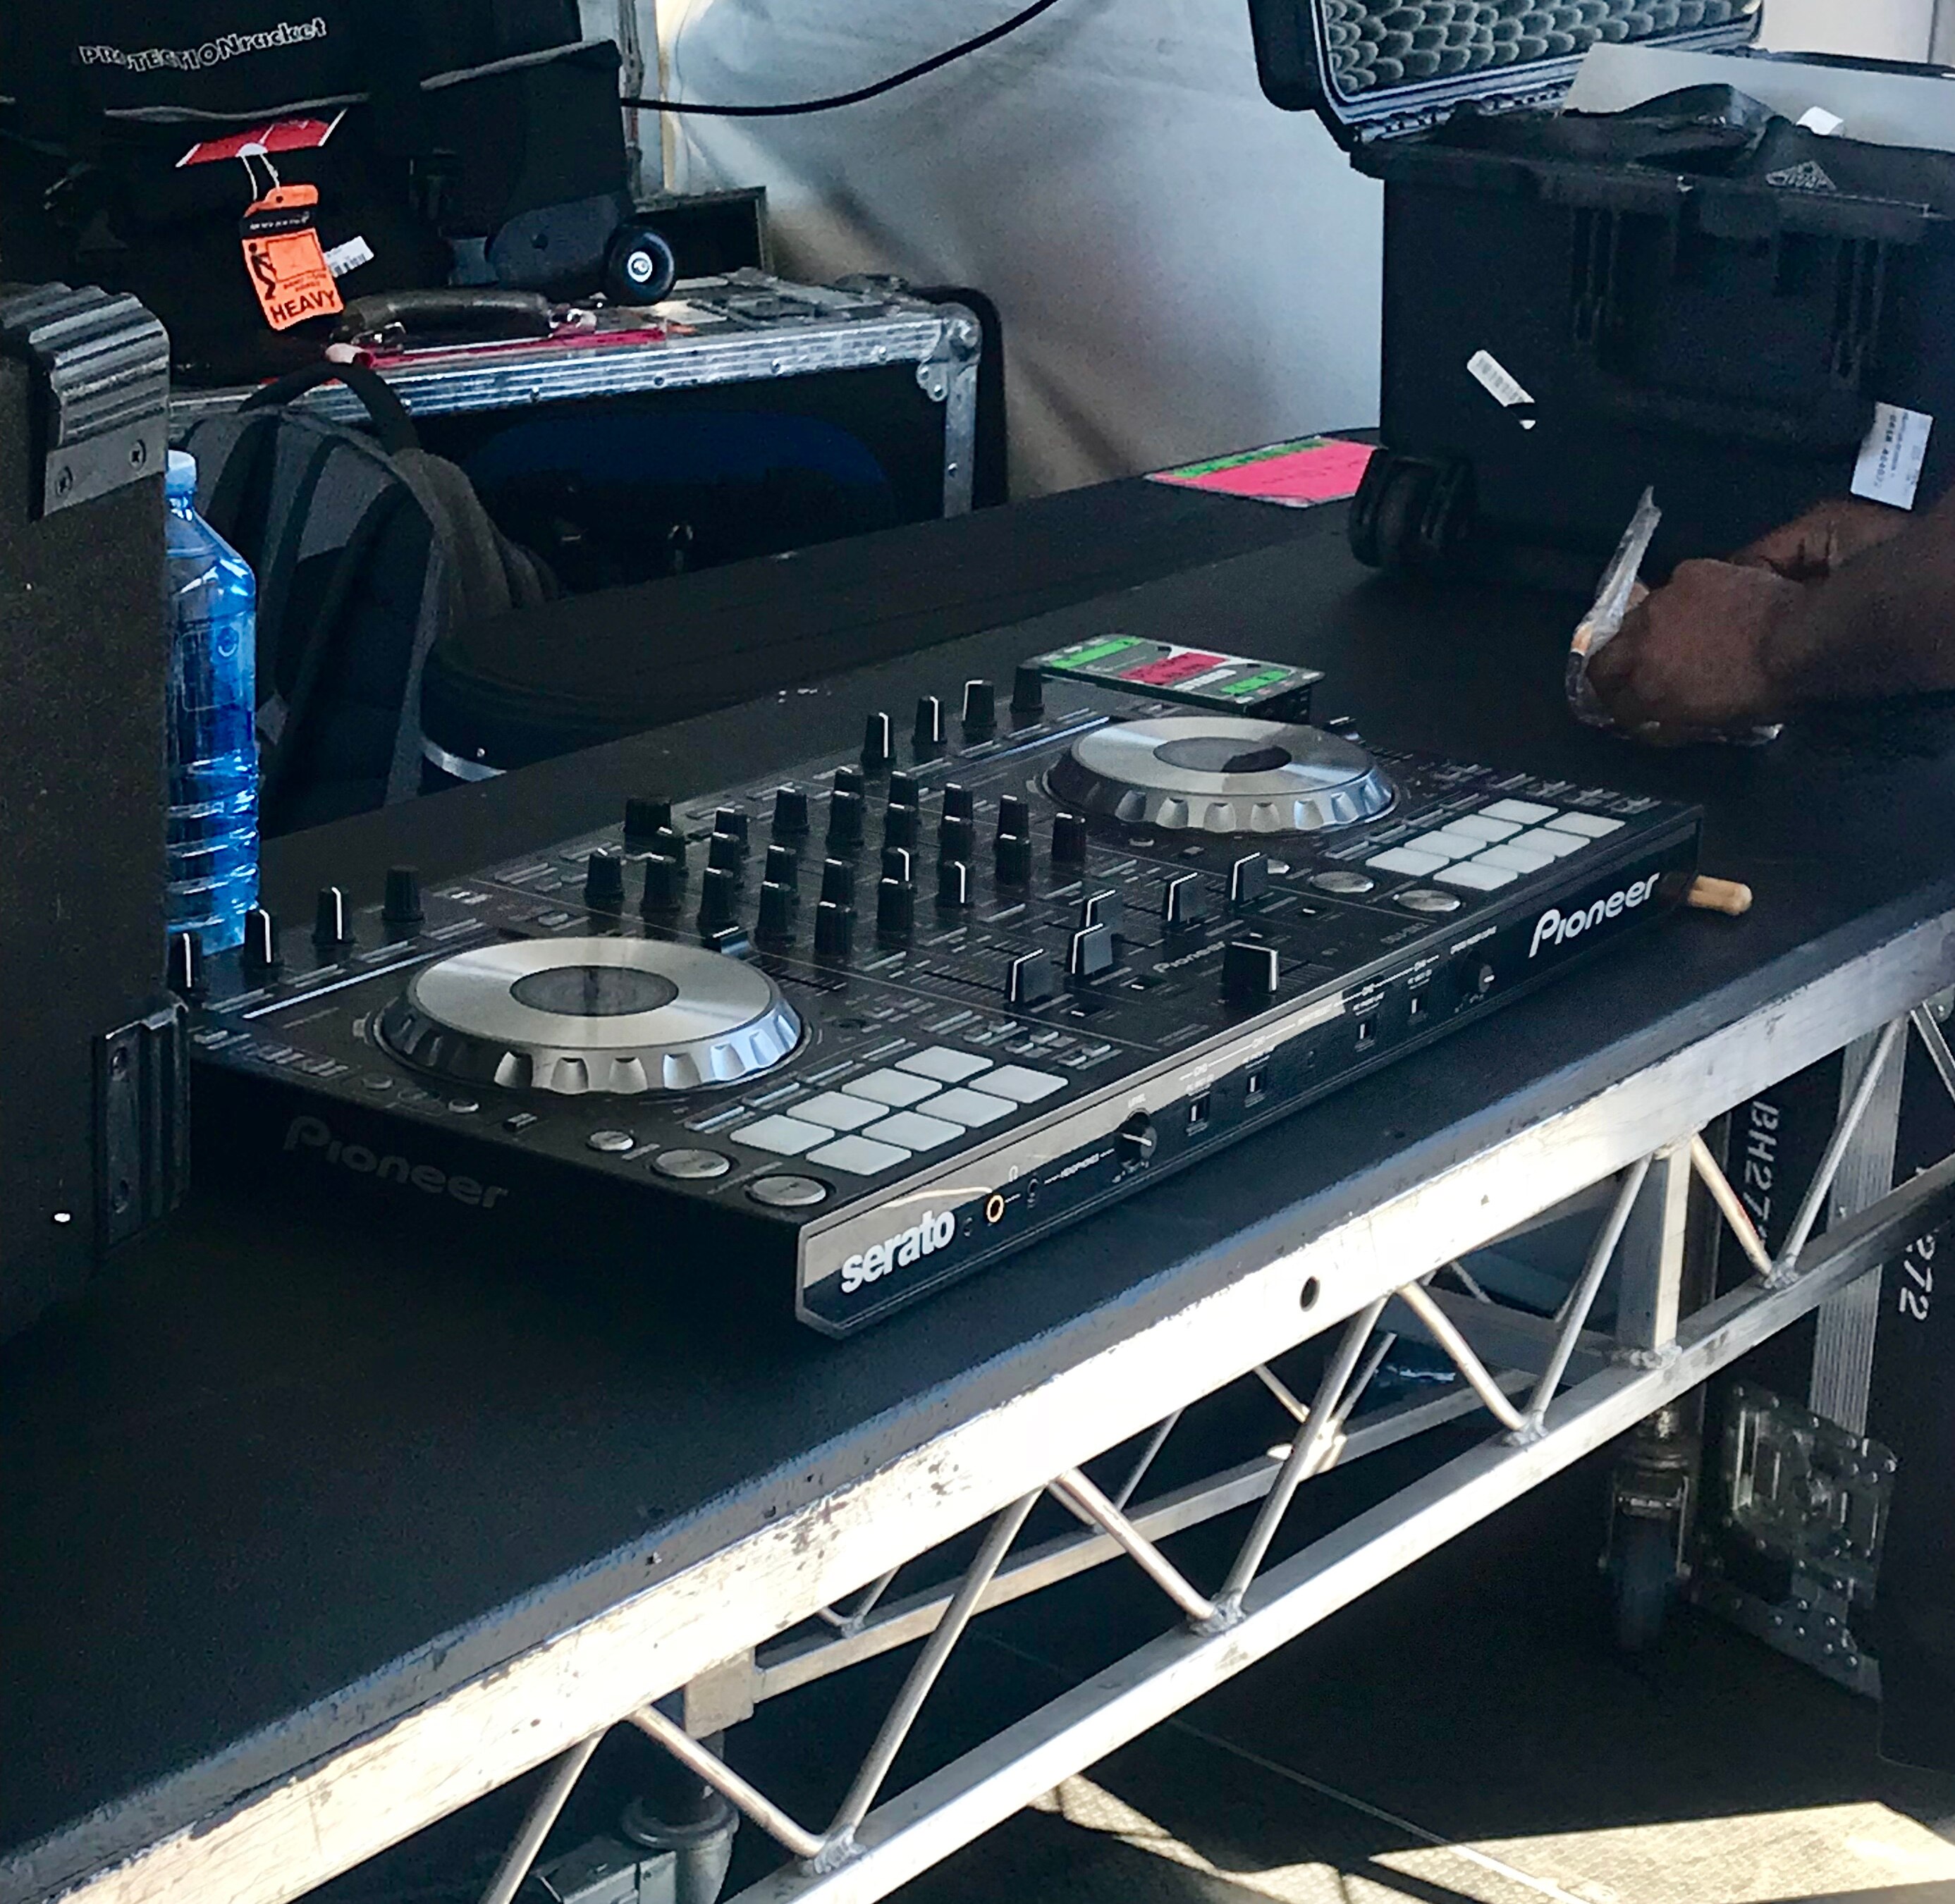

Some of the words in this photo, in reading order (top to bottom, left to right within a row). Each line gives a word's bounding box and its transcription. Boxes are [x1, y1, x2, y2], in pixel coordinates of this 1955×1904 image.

[269, 289, 335, 324] HEAVY
[1528, 871, 1661, 958] Pioneer
[283, 1115, 509, 1209] Pioneer
[1743, 1100, 1780, 1239] BH27
[841, 1210, 956, 1293] serato
[1899, 1229, 1937, 1320] 272
